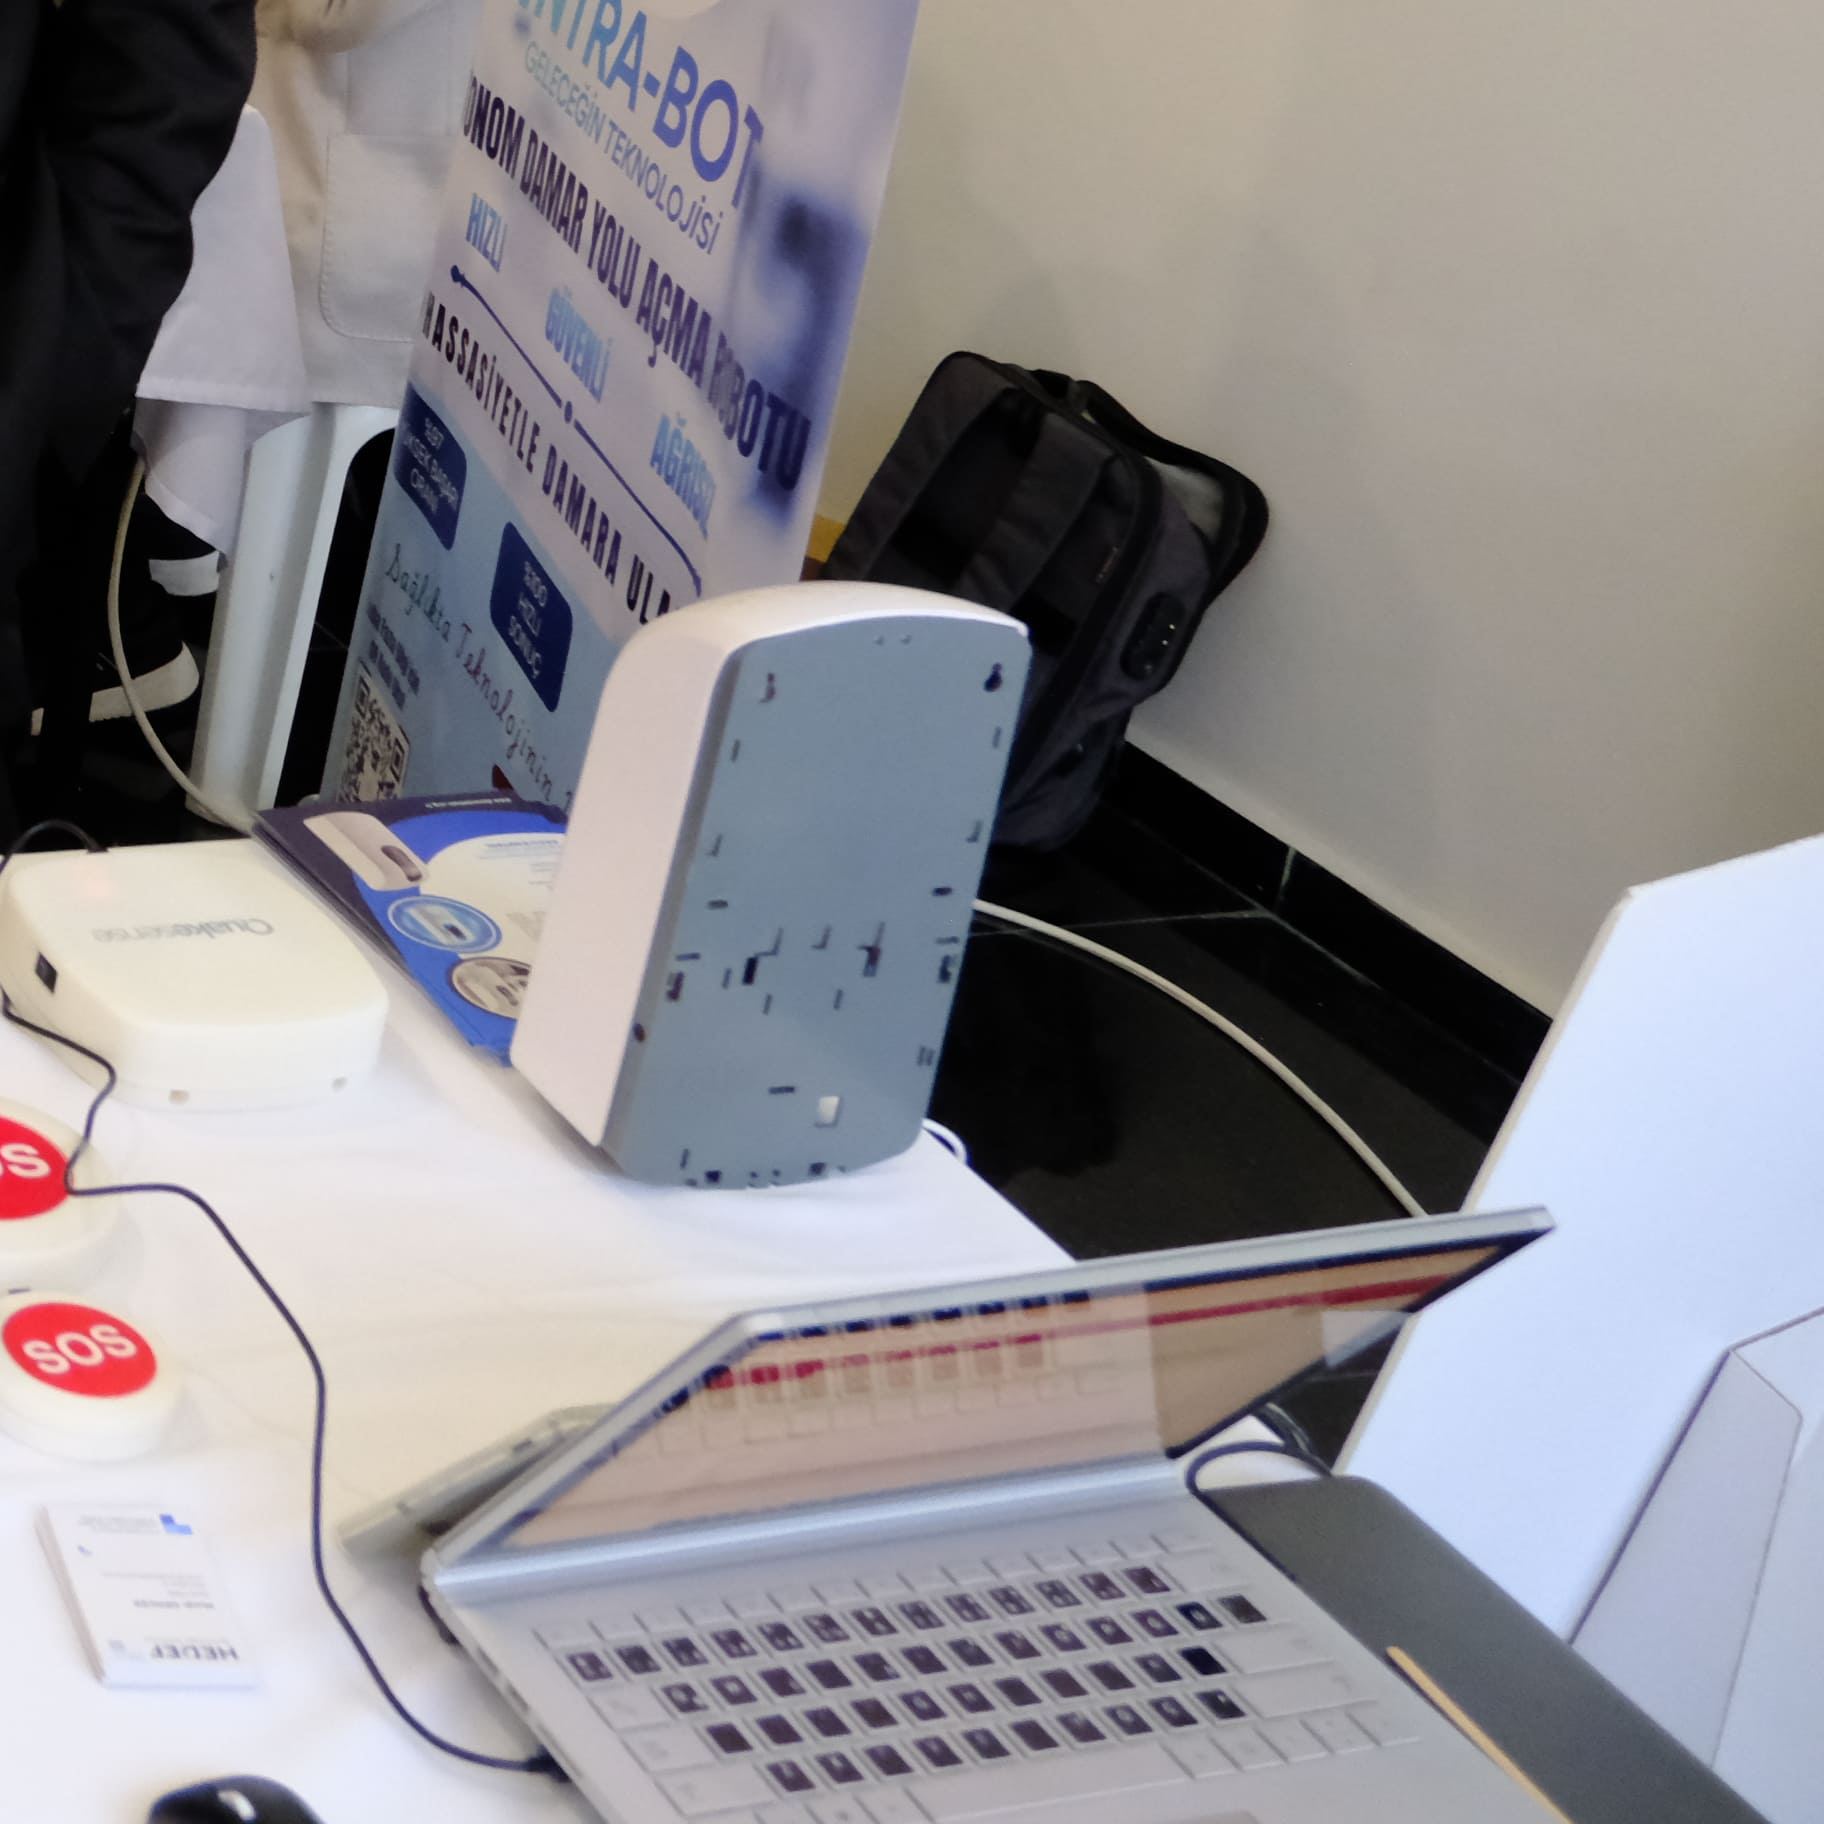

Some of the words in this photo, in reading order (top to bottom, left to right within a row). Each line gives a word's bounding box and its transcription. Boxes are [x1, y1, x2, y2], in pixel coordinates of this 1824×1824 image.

[520, 128, 588, 254] DAMAR
[587, 200, 641, 309] YOLU
[635, 257, 712, 389] AÇMA
[604, 120, 725, 256] TEKNOLOJİSİ
[542, 444, 622, 587] DAMARA
[626, 553, 671, 626] ULA
[21, 1323, 139, 1376] SOS
